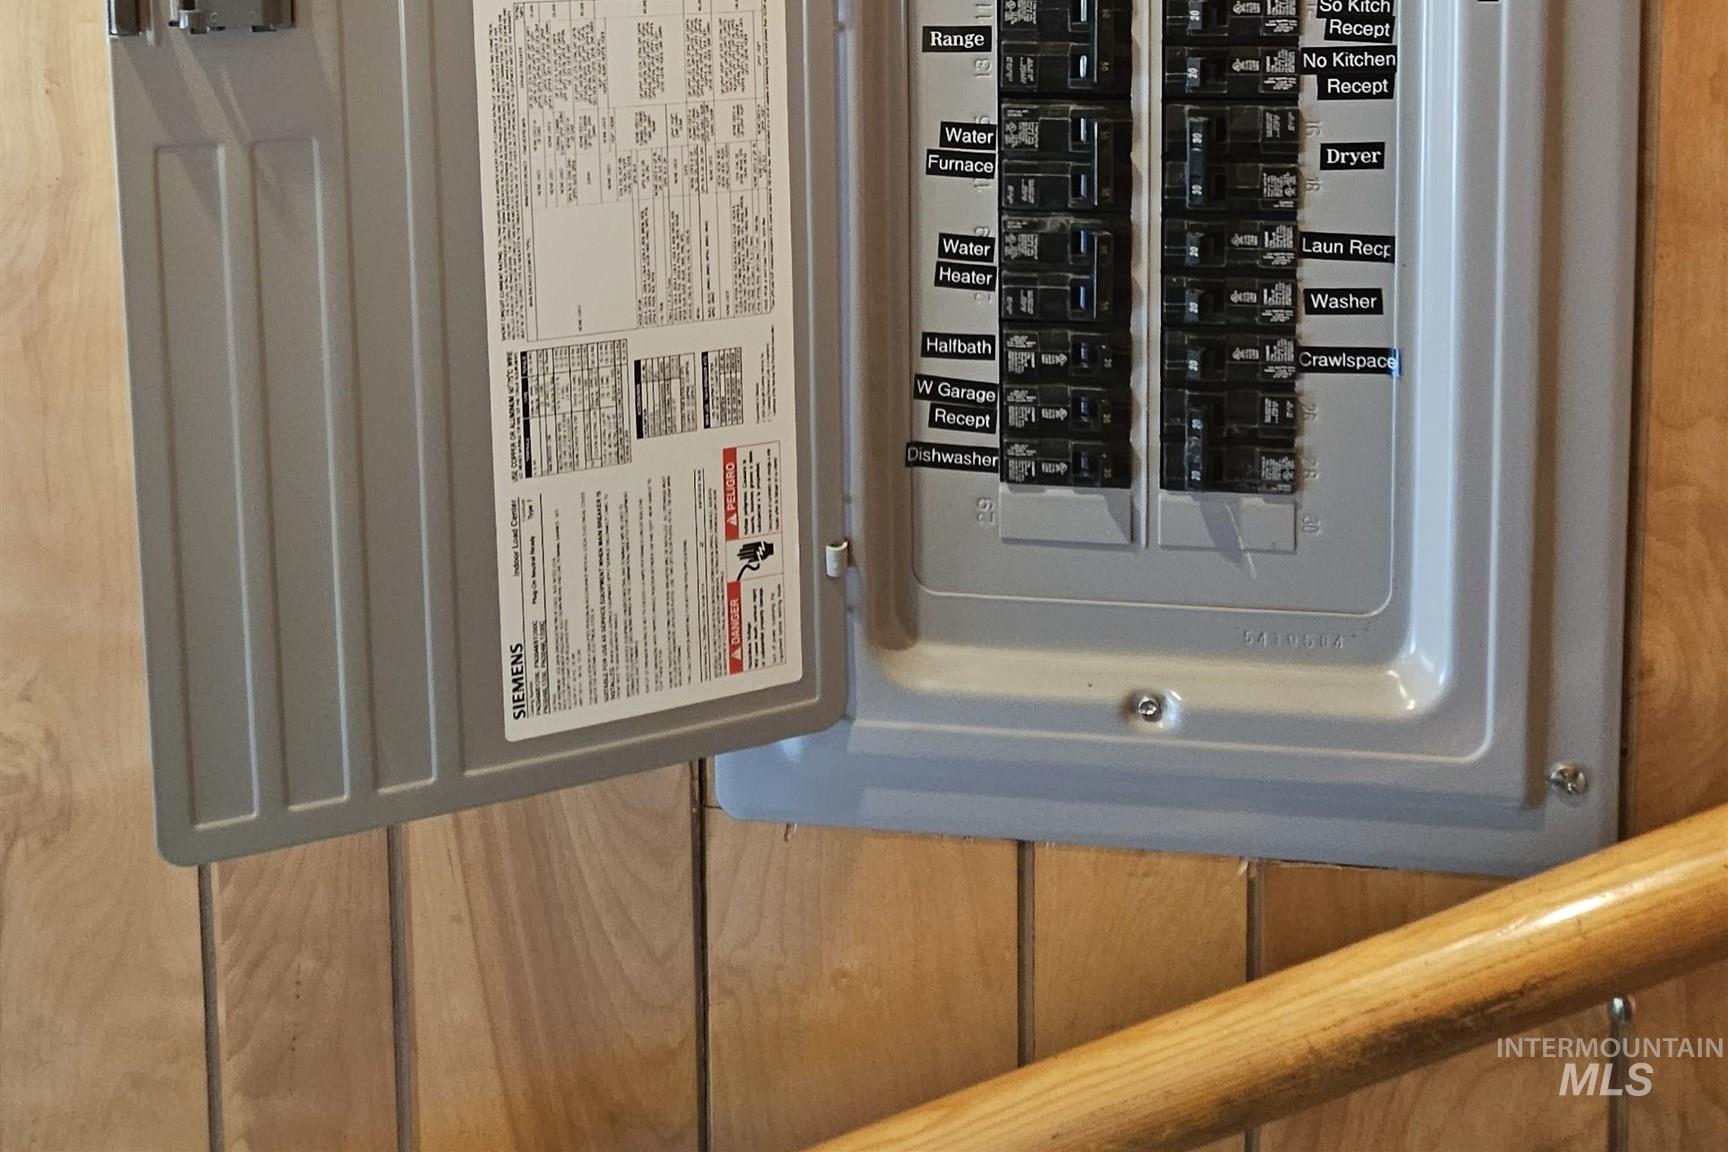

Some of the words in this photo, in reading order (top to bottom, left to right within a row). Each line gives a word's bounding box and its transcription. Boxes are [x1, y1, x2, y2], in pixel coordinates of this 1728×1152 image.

[1190, 10, 1200, 21] 20
[1329, 19, 1390, 38] Recept
[930, 31, 985, 48] Range
[1303, 54, 1327, 68] No
[1333, 52, 1396, 67] Kitchen
[1188, 68, 1198, 78] 20
[1327, 79, 1388, 95] Recept
[945, 127, 994, 144] Water
[928, 155, 994, 173] Furnace
[1327, 149, 1382, 165] Dryer
[1192, 185, 1202, 195] 30
[943, 238, 990, 256] Water
[1189, 247, 1199, 257] 20
[1302, 238, 1343, 254] Laun
[939, 267, 993, 285] Heater
[1189, 303, 1198, 313] 20
[1311, 294, 1377, 309] Washer
[926, 337, 992, 354] Halfbath
[1189, 360, 1198, 371] 20
[1300, 351, 1397, 370] Crawlspace
[916, 380, 934, 394] W
[938, 383, 996, 403] Garage
[934, 408, 990, 428] Recept
[907, 448, 999, 468] Dishwasher
[725, 462, 736, 511] PELIGRO
[510, 499, 518, 527] Center
[730, 598, 740, 645] DANGER
[510, 643, 526, 720] SIEMENS
